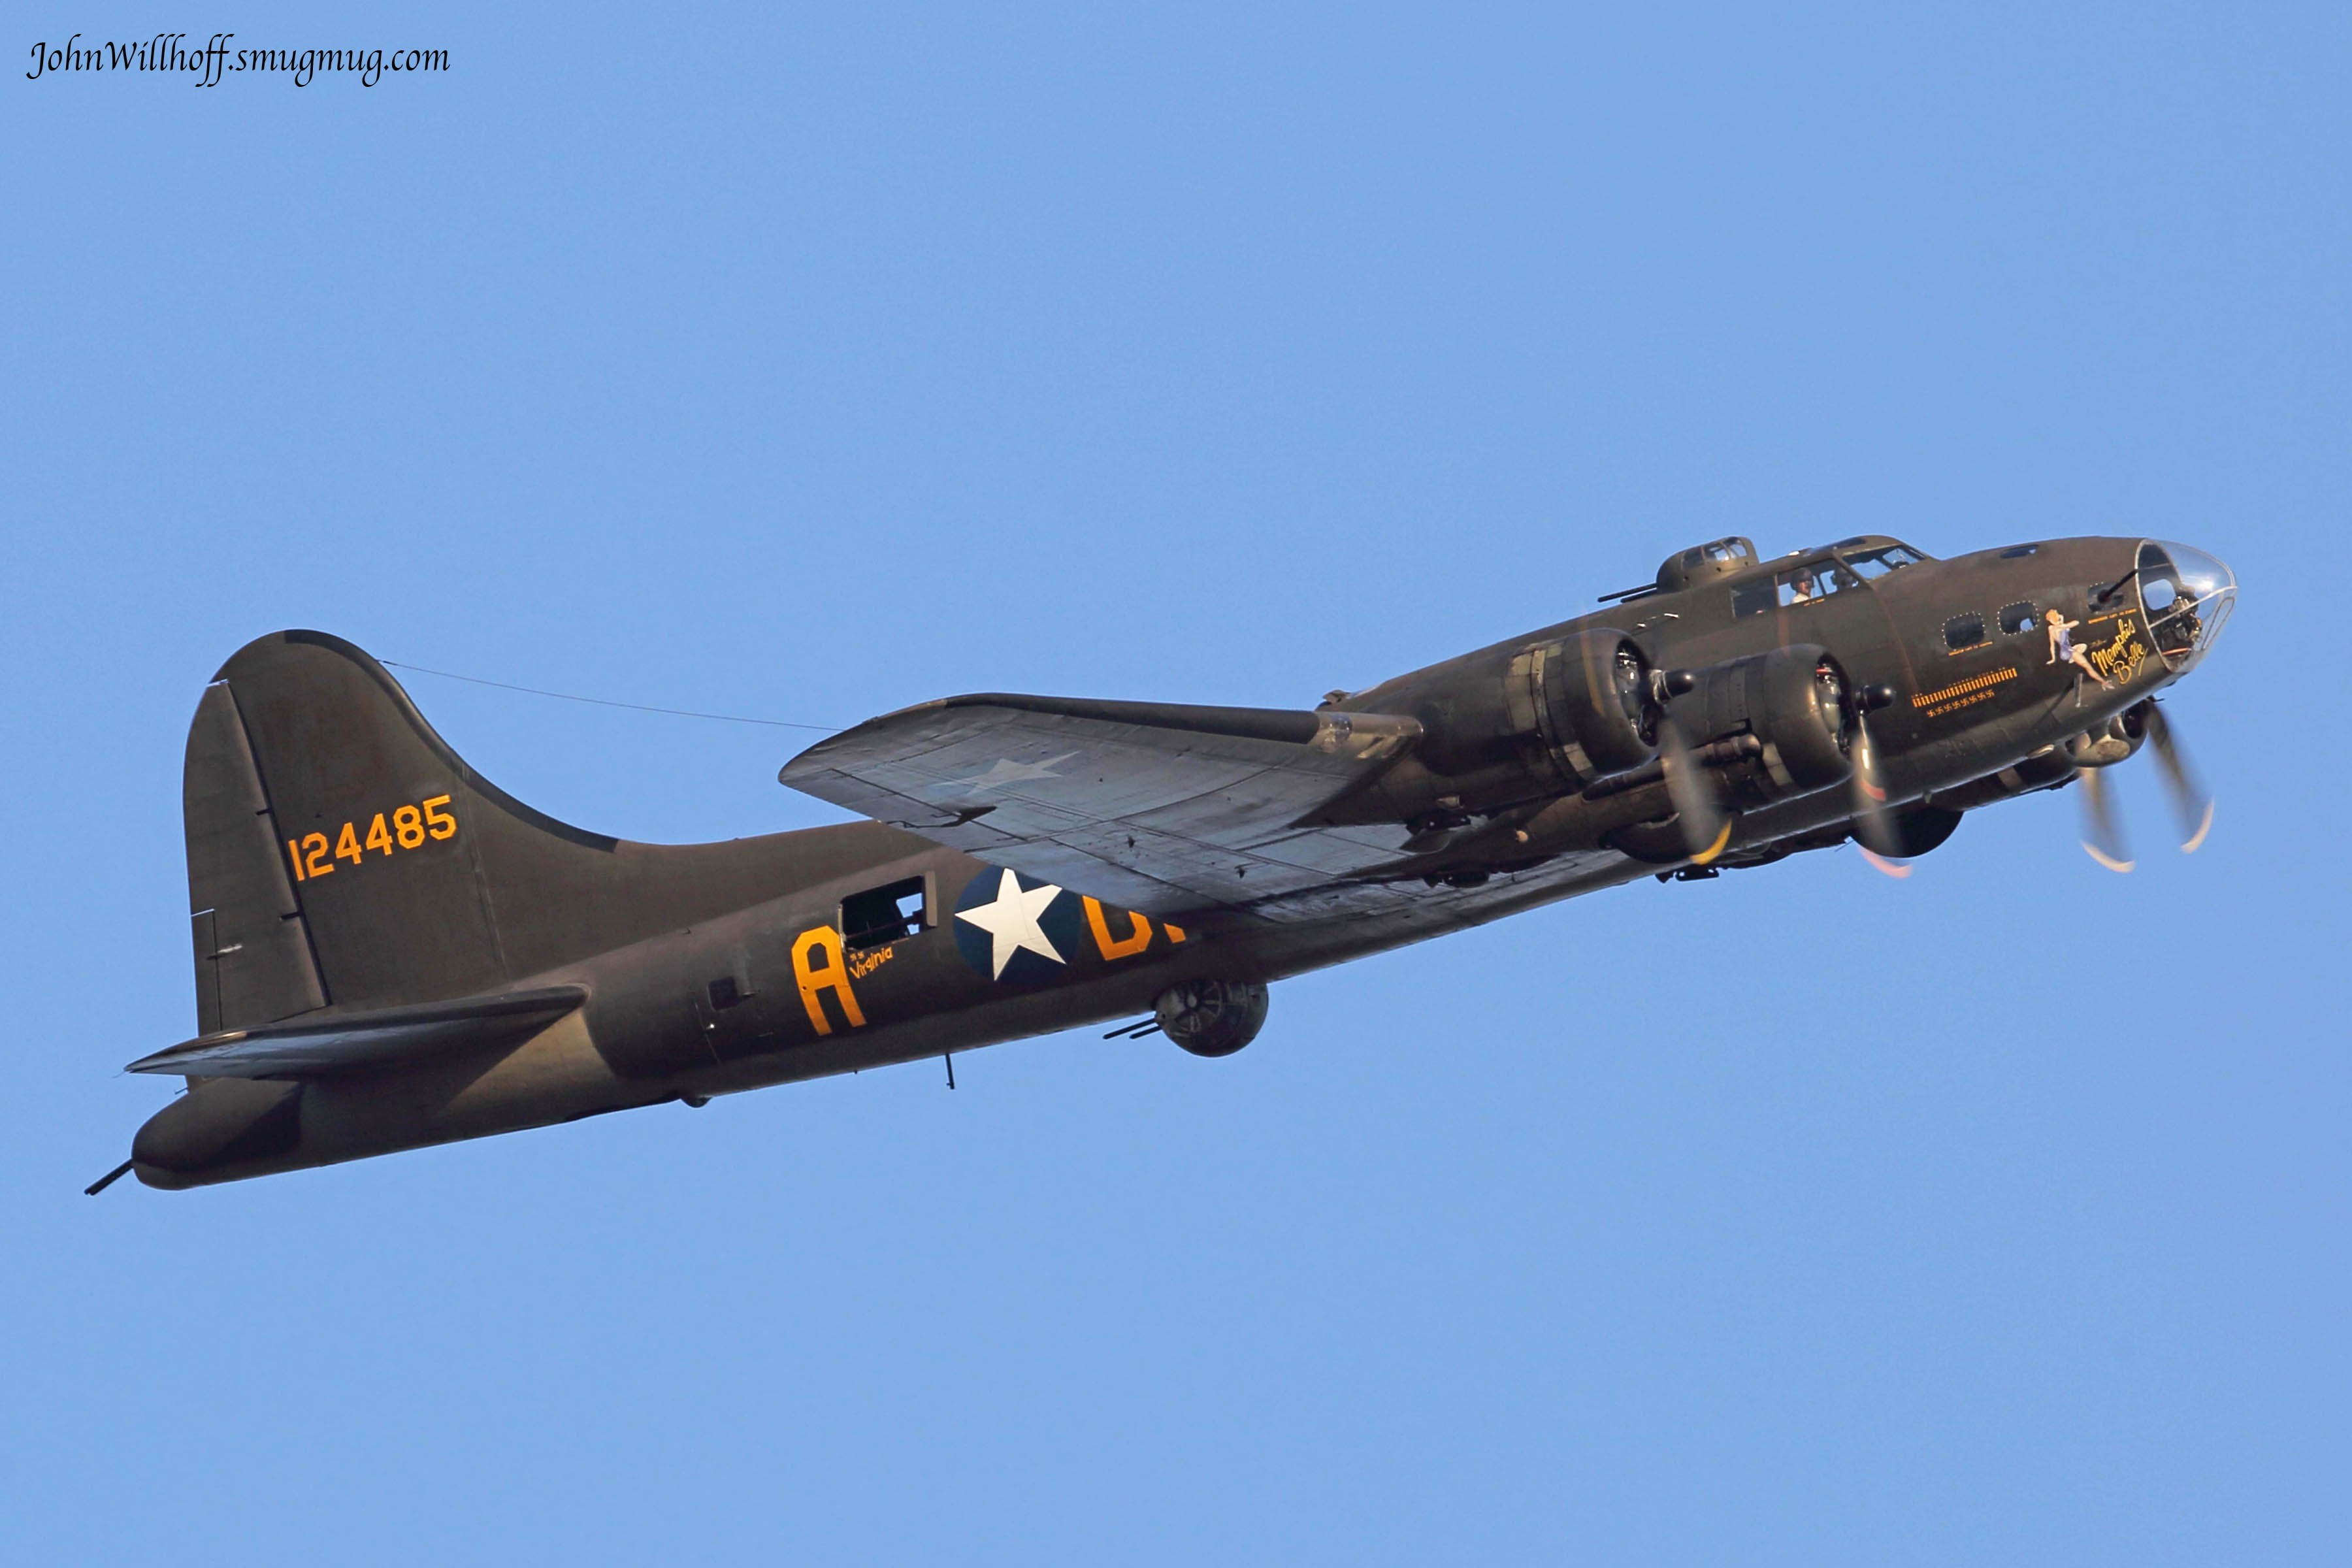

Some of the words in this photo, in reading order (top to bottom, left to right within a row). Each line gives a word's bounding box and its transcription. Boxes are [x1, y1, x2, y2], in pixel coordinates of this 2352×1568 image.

[2091, 619, 2135, 676] Memphis
[2113, 642, 2146, 684] Belle
[288, 794, 457, 881] 124485
[791, 925, 867, 1036] A
[850, 947, 892, 978] Virginia
